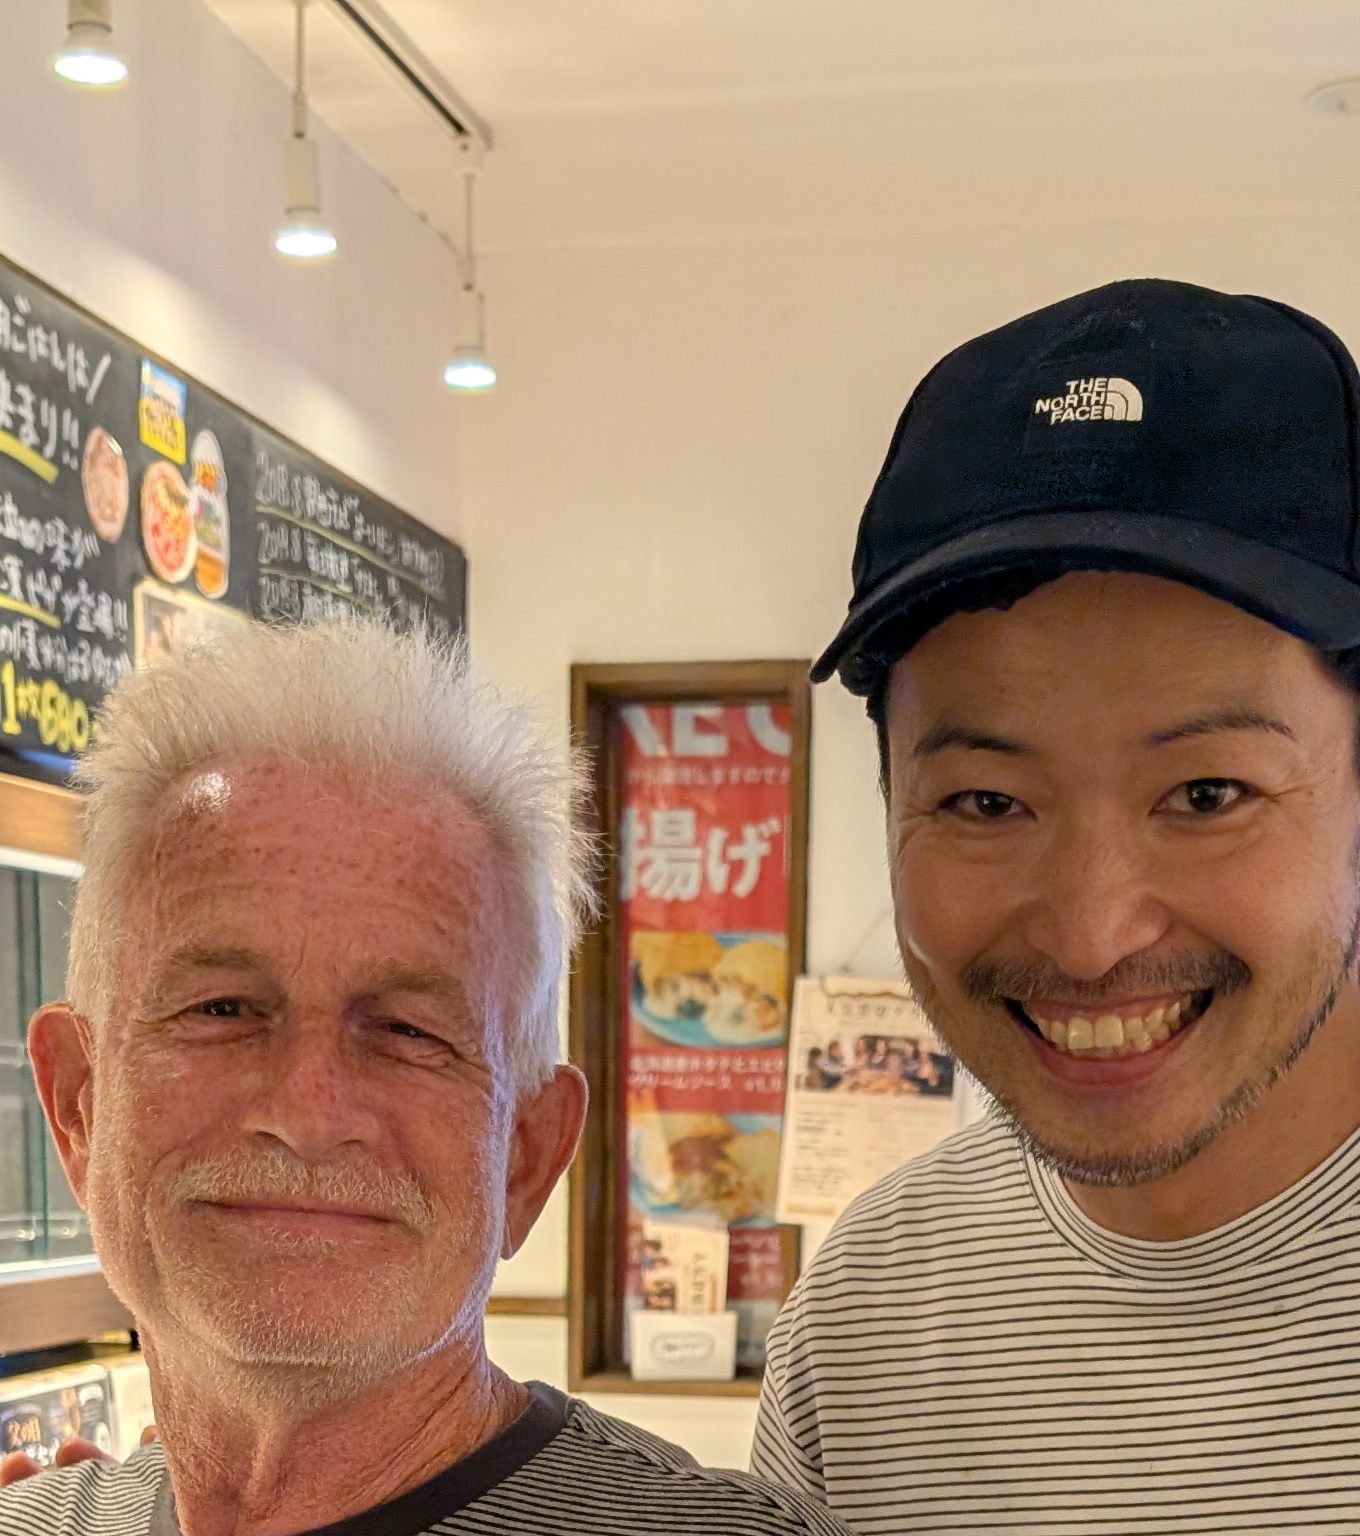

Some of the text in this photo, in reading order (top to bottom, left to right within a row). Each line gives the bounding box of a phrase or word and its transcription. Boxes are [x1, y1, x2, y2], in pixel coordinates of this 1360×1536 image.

[1066, 377, 1108, 393] THE
[1035, 391, 1107, 414] NORTH
[1050, 405, 1104, 426] FACE
[619, 807, 782, 903] 揚げ
